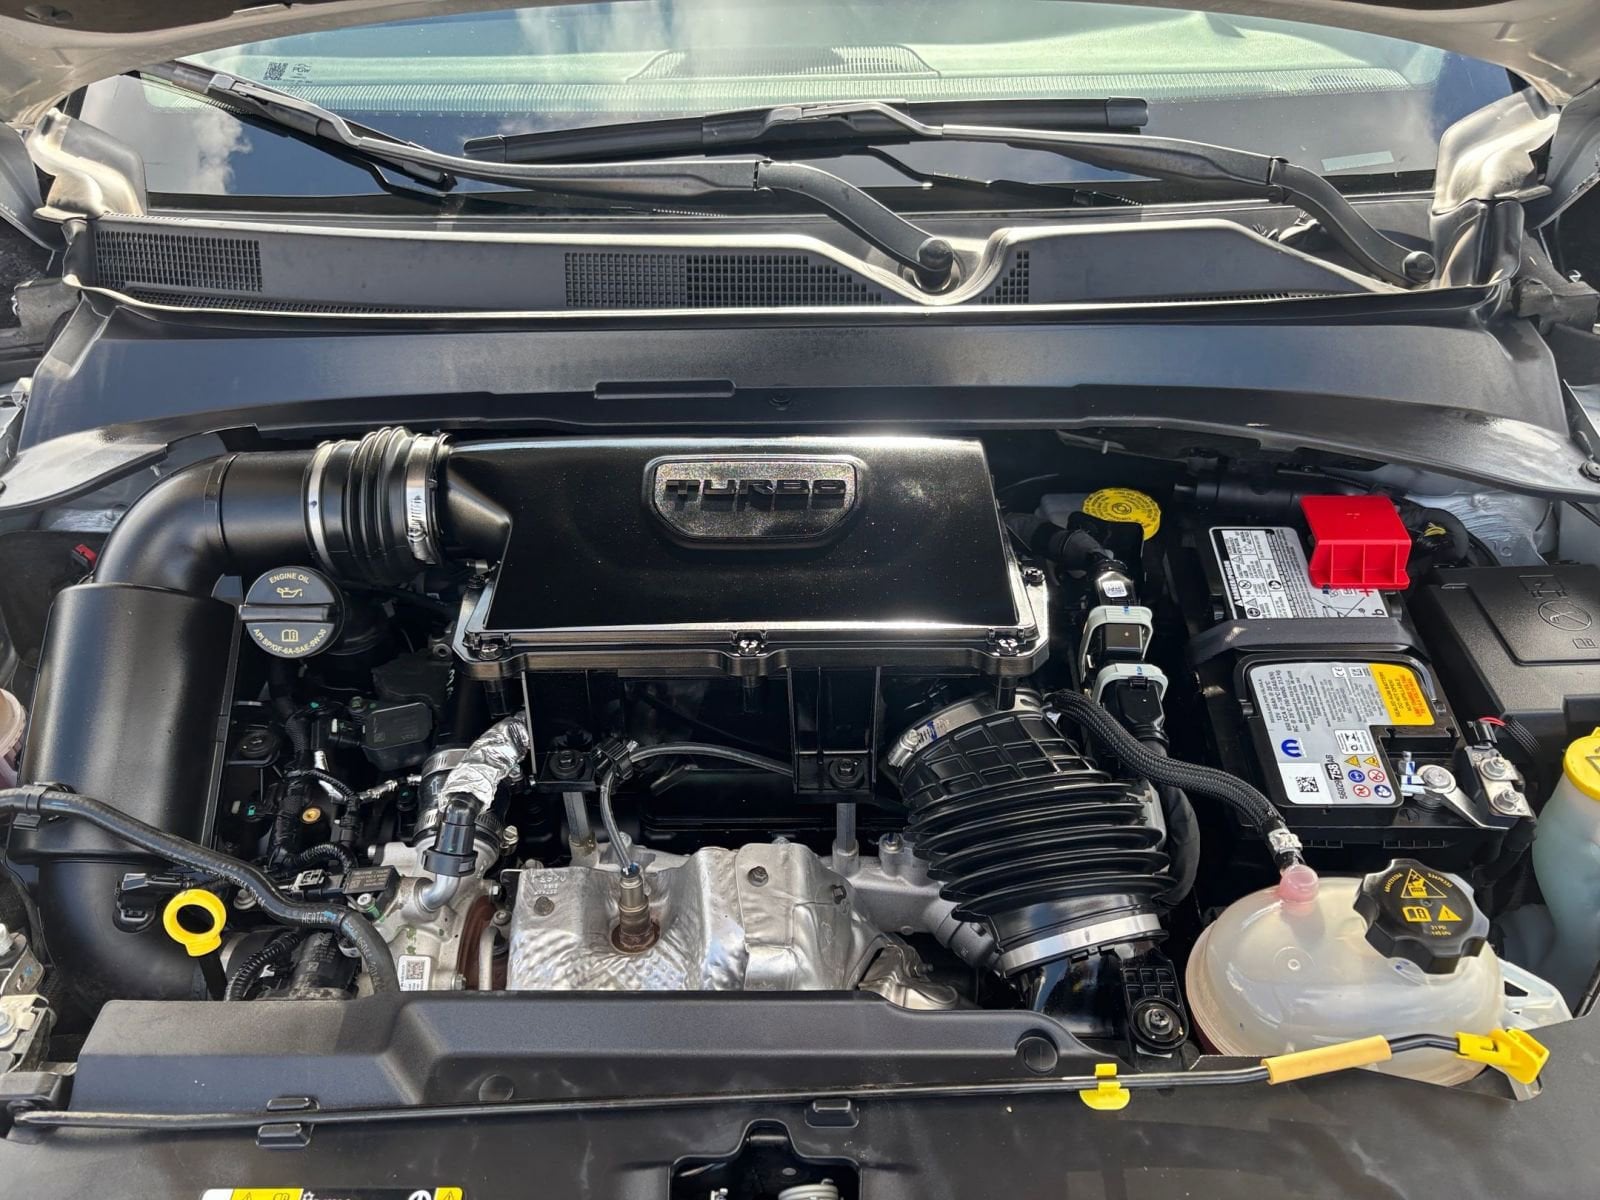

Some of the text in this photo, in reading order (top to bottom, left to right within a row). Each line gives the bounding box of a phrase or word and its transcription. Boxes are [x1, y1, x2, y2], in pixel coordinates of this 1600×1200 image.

[664, 479, 847, 506] TURBO
[268, 572, 311, 584] ENGINE OIL
